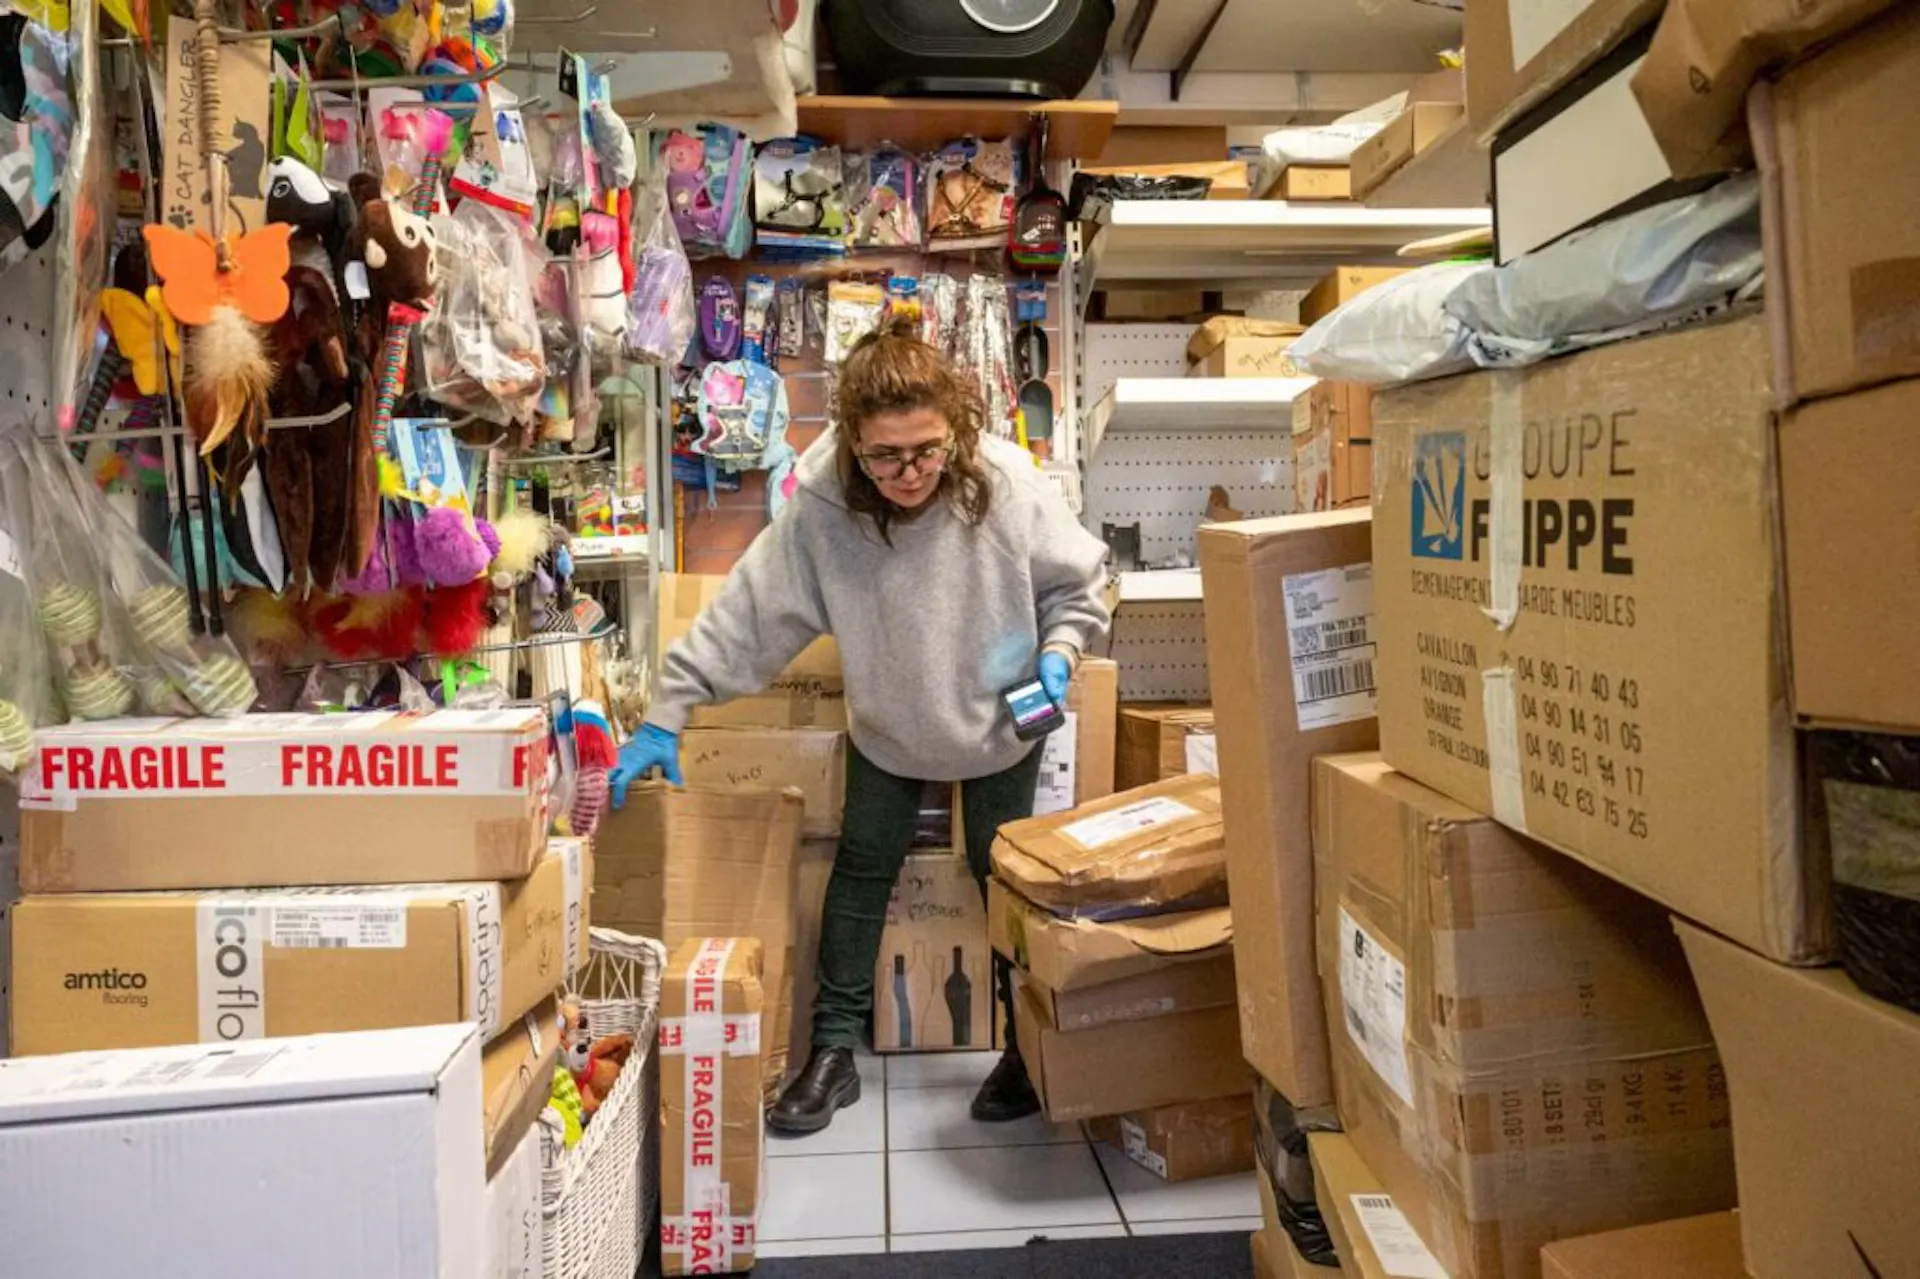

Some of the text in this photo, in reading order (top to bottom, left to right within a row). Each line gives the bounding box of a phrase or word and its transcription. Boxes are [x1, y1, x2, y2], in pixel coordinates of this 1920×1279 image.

[176, 39, 199, 200] CAT DANGLER
[1474, 408, 1637, 481] GOUPE
[1471, 498, 1635, 576] FIPPE
[1518, 583, 1557, 616] ARDE
[1562, 588, 1636, 629] MEUBLES
[1517, 656, 1639, 709] 04 90 71 40 43
[1521, 694, 1642, 754] 04 90 14 31 05
[40, 744, 459, 790] FRAGILE FRAGILE
[1525, 732, 1541, 760] 04
[1548, 739, 1565, 768] 90
[1571, 747, 1588, 776] 51
[1625, 766, 1643, 796] 17
[1530, 769, 1648, 839] 04 42 63 75 25
[64, 968, 147, 990] amtico
[692, 1056, 714, 1167] FRAGILE
